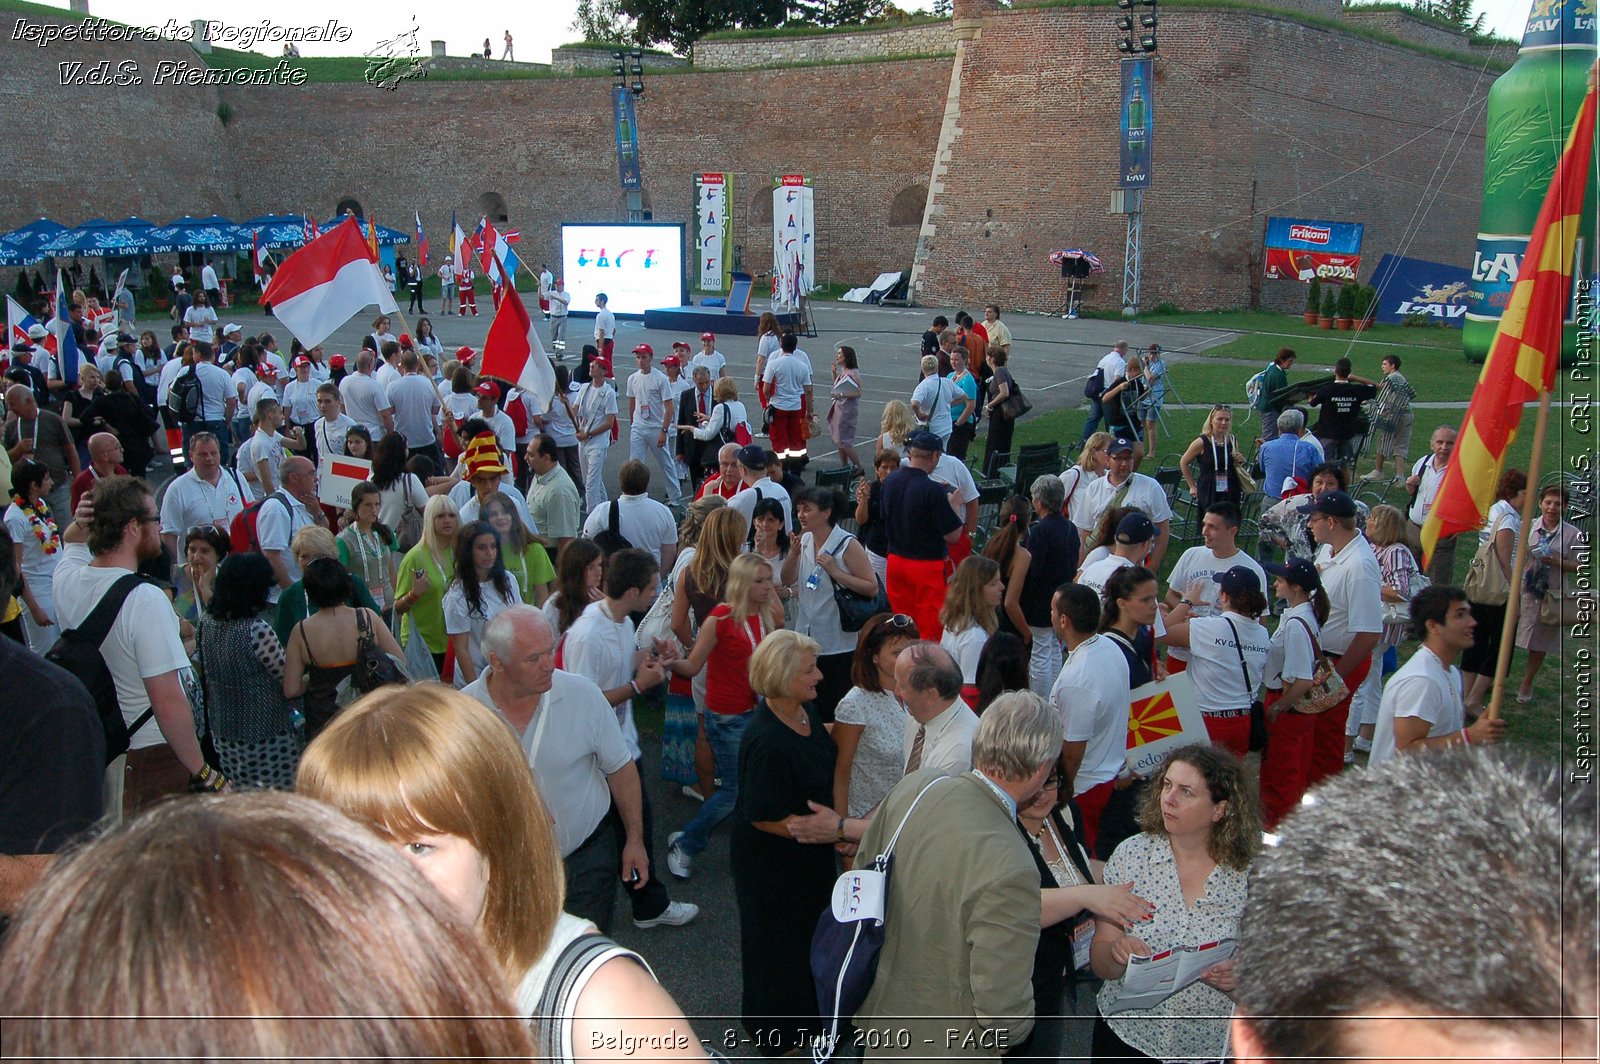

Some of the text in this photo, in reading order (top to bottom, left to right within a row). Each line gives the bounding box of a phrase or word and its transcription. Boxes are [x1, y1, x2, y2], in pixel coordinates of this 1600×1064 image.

[1525, 18, 1560, 34] LAV
[1574, 17, 1597, 30] LA
[1126, 174, 1146, 182] LAV
[1291, 228, 1328, 241] Frikom
[83, 245, 172, 257] LAV LAV LAV
[1471, 250, 1526, 283] LA
[703, 277, 721, 286] 2010
[1394, 301, 1468, 318] LAV
[335, 494, 351, 505] Mon
[1214, 637, 1227, 646] KV
